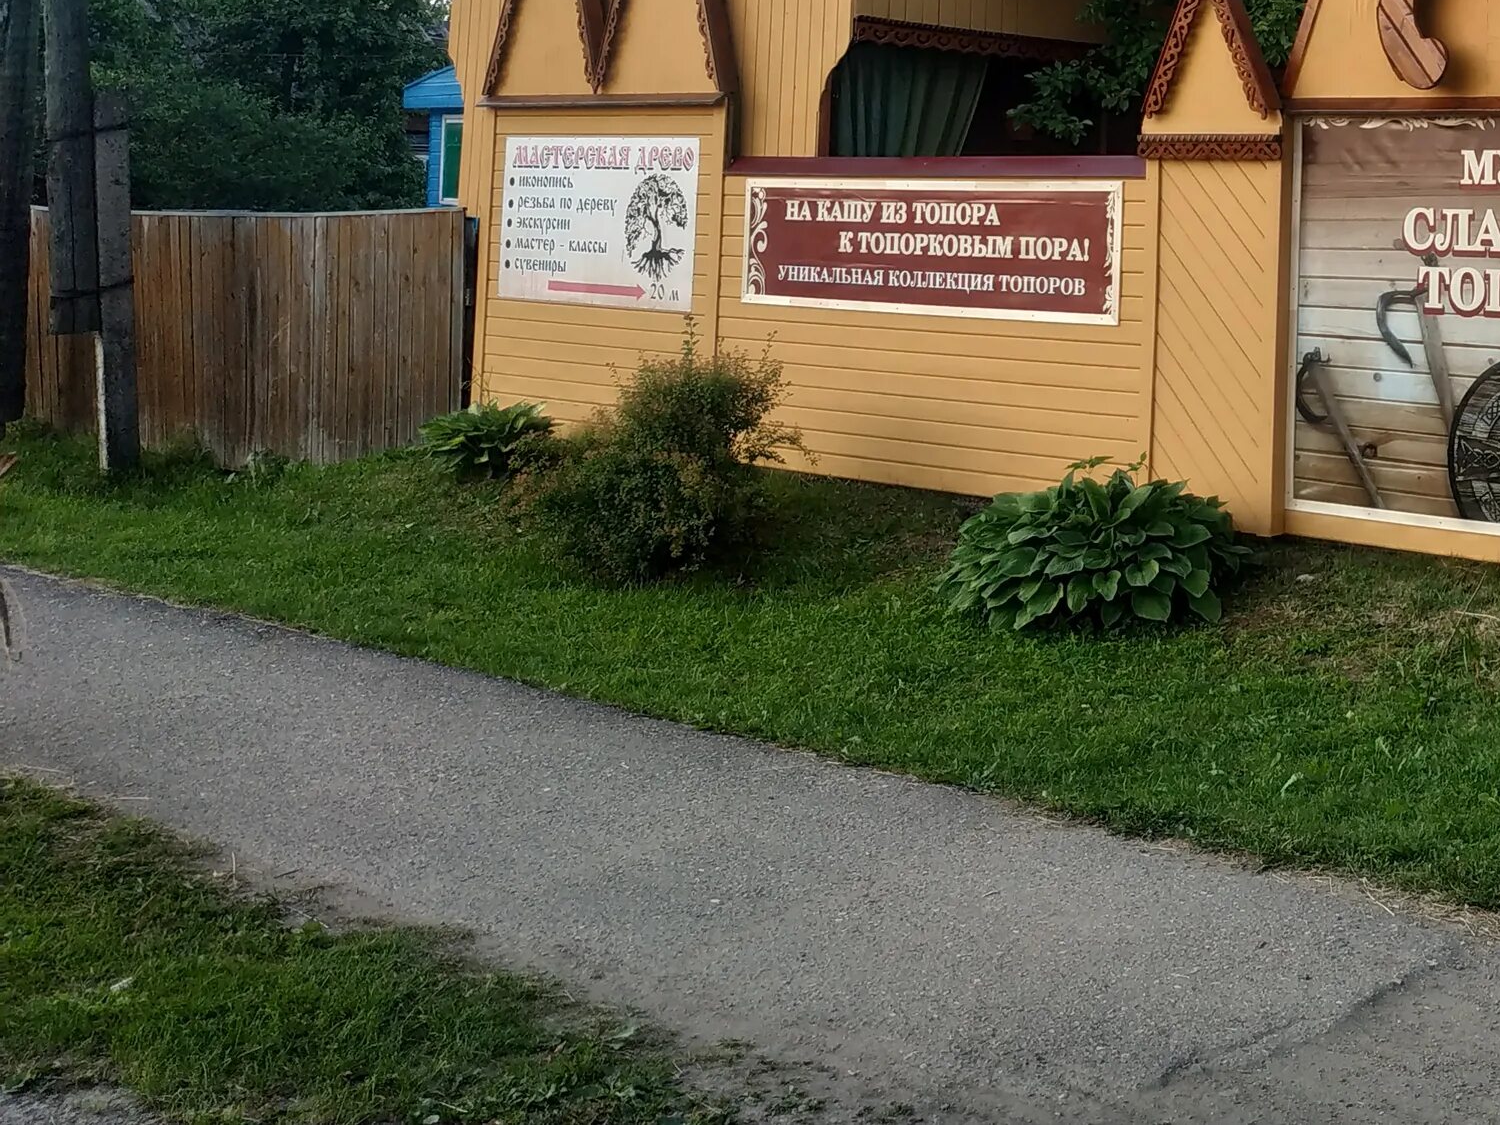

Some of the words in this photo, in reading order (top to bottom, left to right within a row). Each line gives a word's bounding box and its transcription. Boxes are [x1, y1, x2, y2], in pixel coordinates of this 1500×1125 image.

[512, 145, 632, 170] МАСТЕРСКАЯ
[634, 146, 695, 175] ДРЕВО
[784, 200, 812, 222] НА
[816, 201, 876, 223] КАШУ
[880, 202, 908, 224] ИЗ
[912, 202, 1000, 226] ТОПОРА
[838, 232, 853, 253] К
[857, 232, 1013, 259] ТОПОРКОВЫМ
[1018, 236, 1090, 262] ПОРА!
[650, 283, 665, 301] 20
[778, 264, 884, 287] УНИКАЛЬНАЯ
[888, 269, 995, 294] КОЛЛЕКЦИЯ
[999, 275, 1086, 296] ТОПОРОВ
